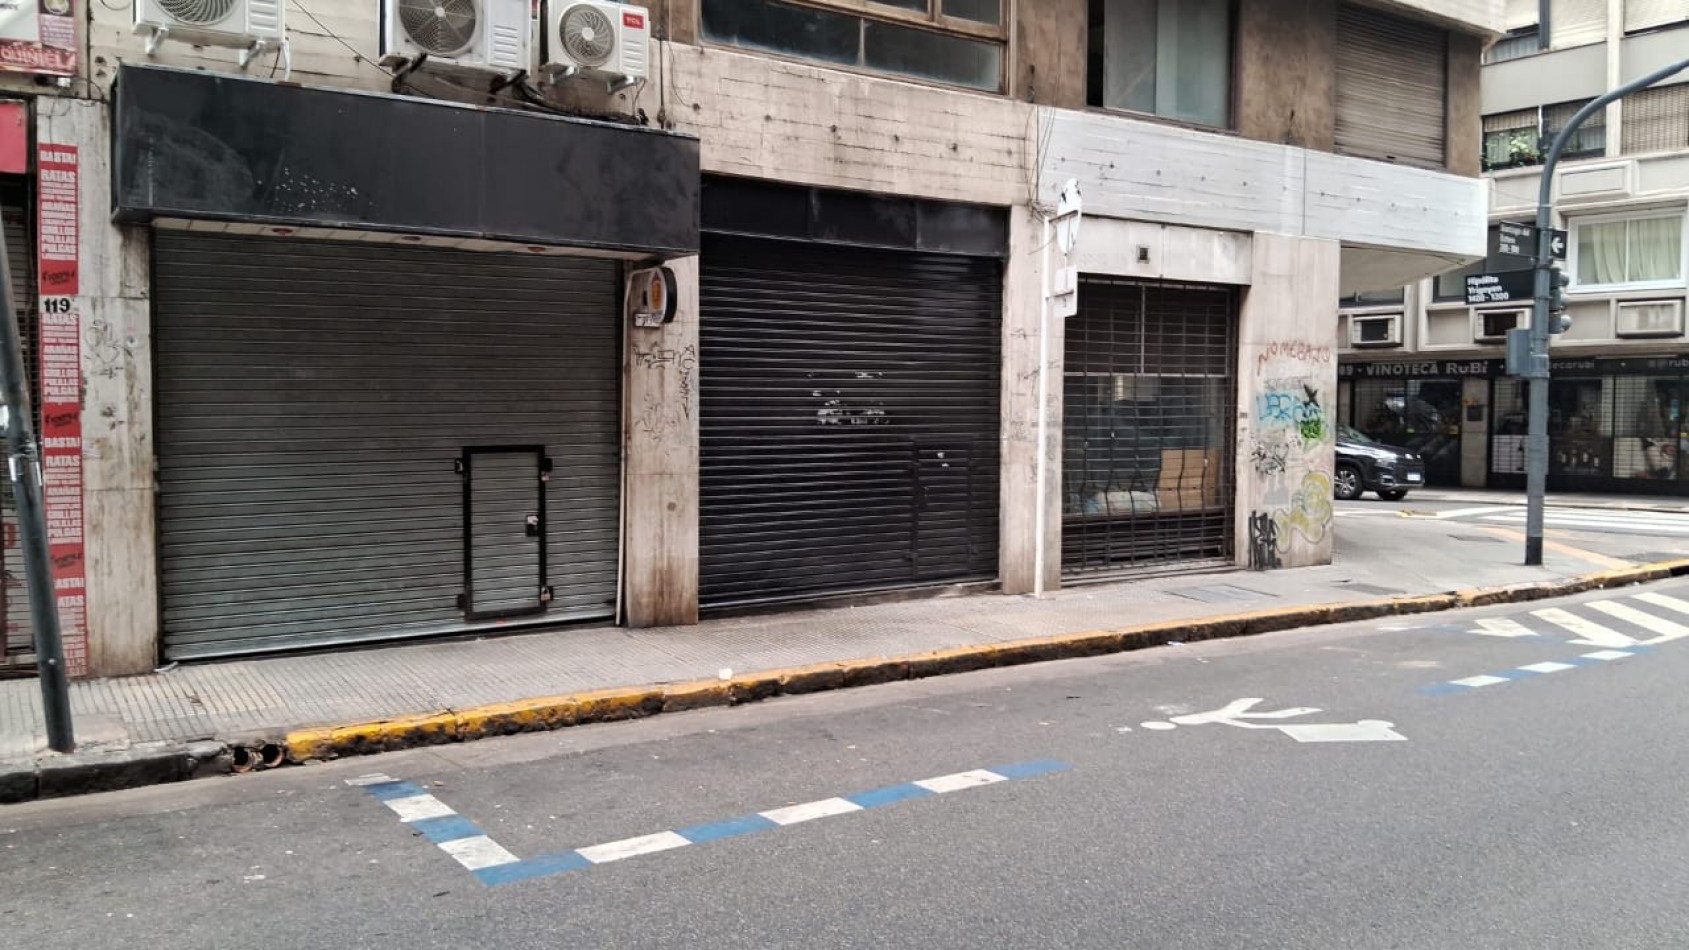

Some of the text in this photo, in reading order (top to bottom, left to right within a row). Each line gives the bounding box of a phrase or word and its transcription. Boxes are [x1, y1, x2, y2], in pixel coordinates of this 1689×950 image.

[625, 17, 642, 26] TCL
[41, 169, 76, 183] RATAS
[44, 297, 71, 313] 119
[43, 313, 78, 325] RATAS
[1366, 363, 1439, 375] VINOTECA
[44, 437, 80, 448] BASTA!
[45, 455, 80, 467] RATAS
[54, 578, 85, 589] ASTA!
[57, 595, 85, 608] ATAS
